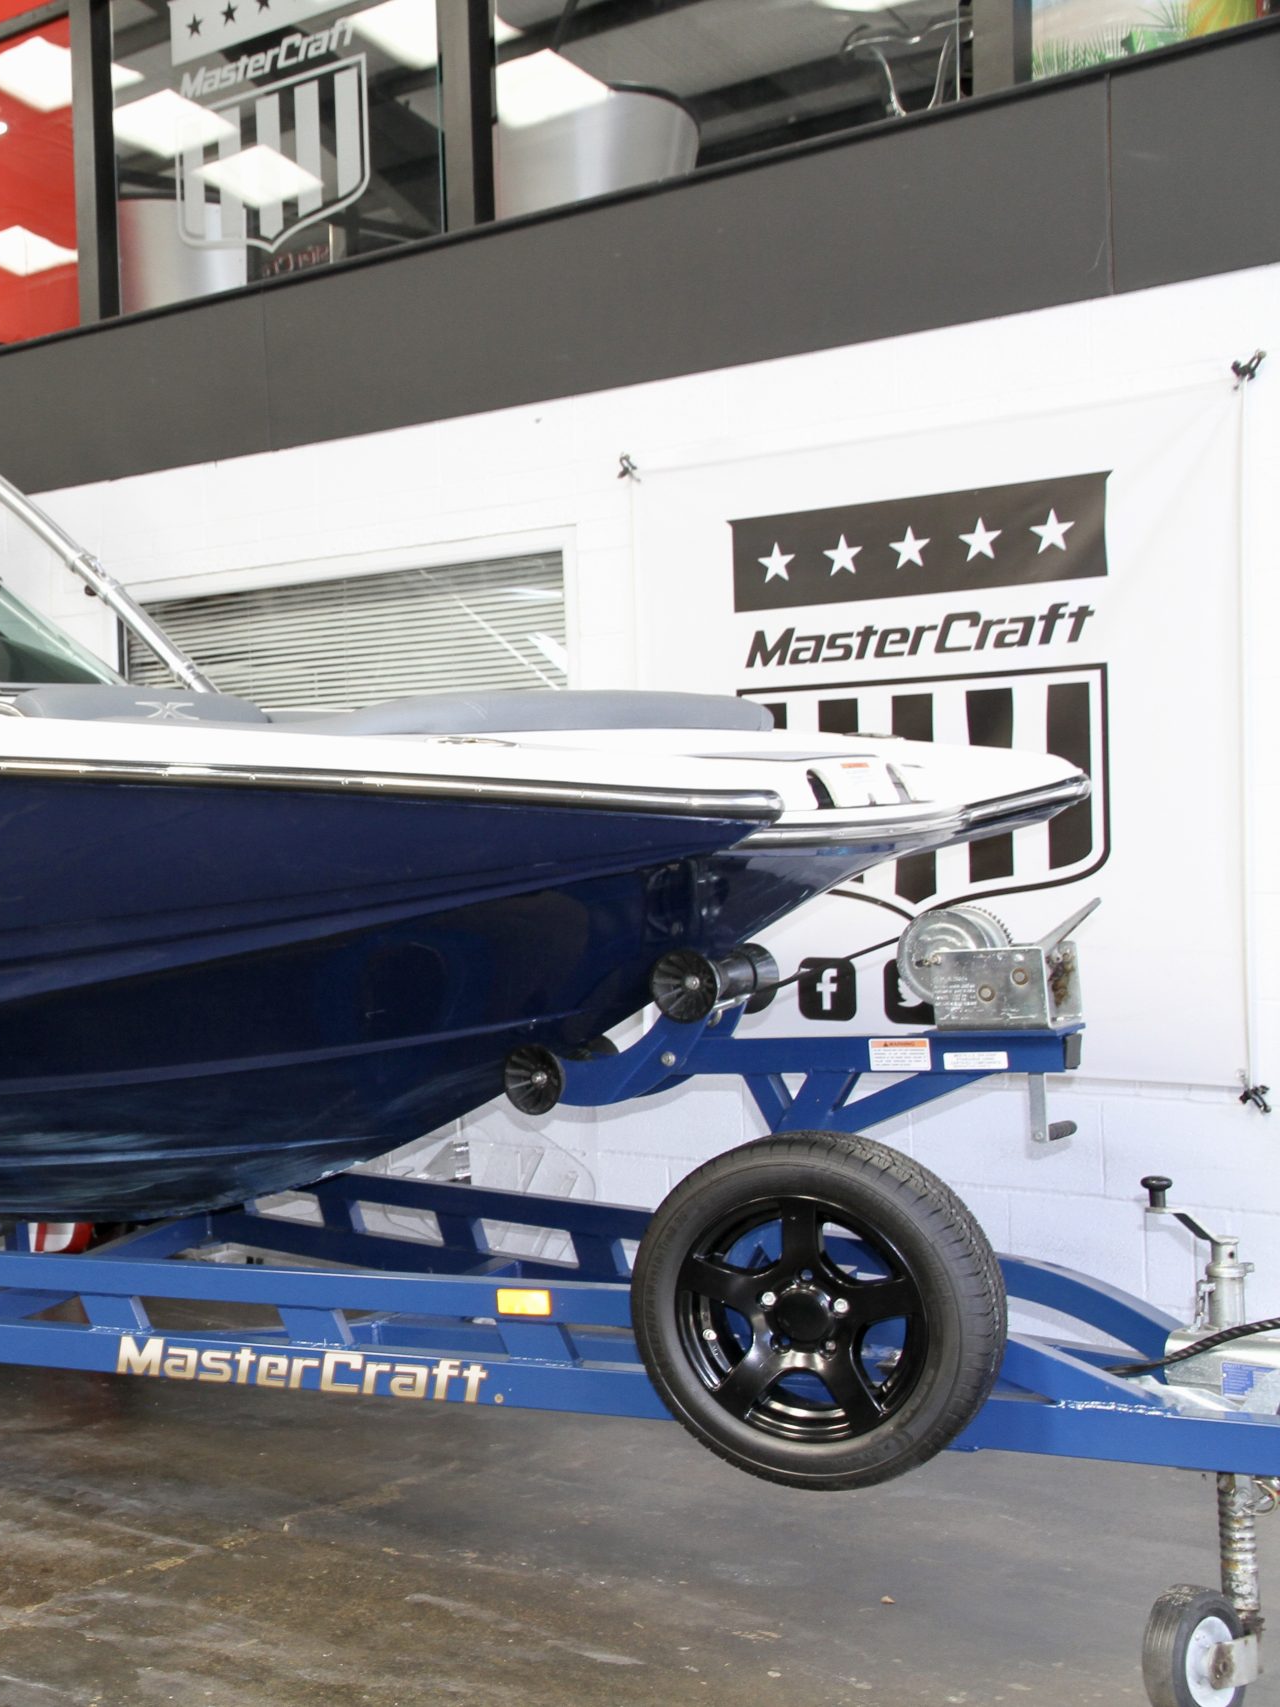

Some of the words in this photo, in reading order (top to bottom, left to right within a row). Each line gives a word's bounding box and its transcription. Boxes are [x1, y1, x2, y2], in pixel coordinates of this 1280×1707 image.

[180, 16, 354, 99] MasterCraft
[744, 602, 1096, 669] MasterCraft
[116, 1337, 488, 1404] MasterCraft
